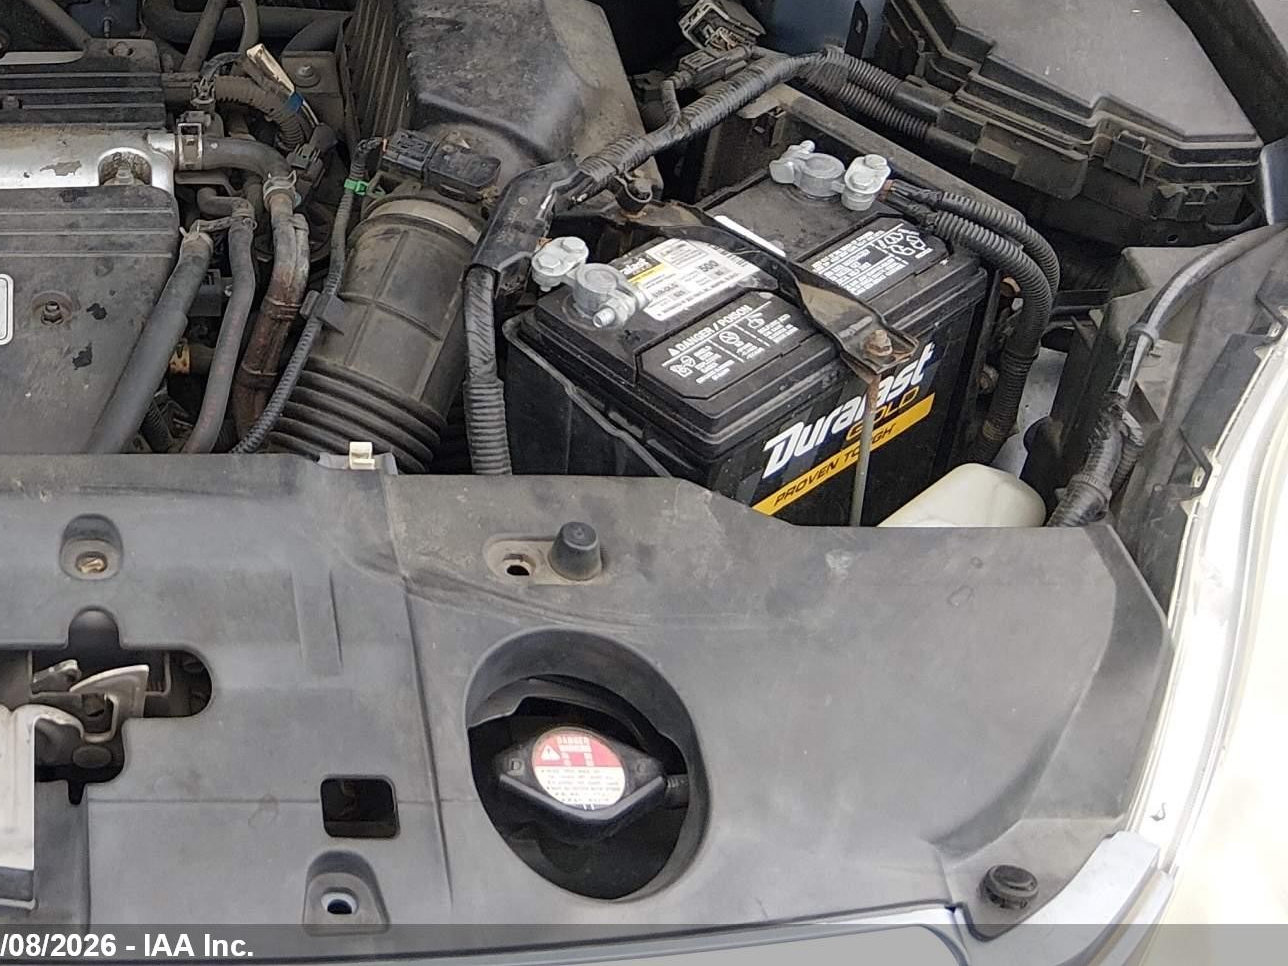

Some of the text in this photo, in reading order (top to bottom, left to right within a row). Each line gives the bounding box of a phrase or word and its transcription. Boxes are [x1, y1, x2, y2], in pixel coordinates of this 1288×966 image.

[675, 326, 715, 352] DANGER
[717, 304, 753, 327] POISON
[774, 422, 897, 506] PROVEN TOGH
